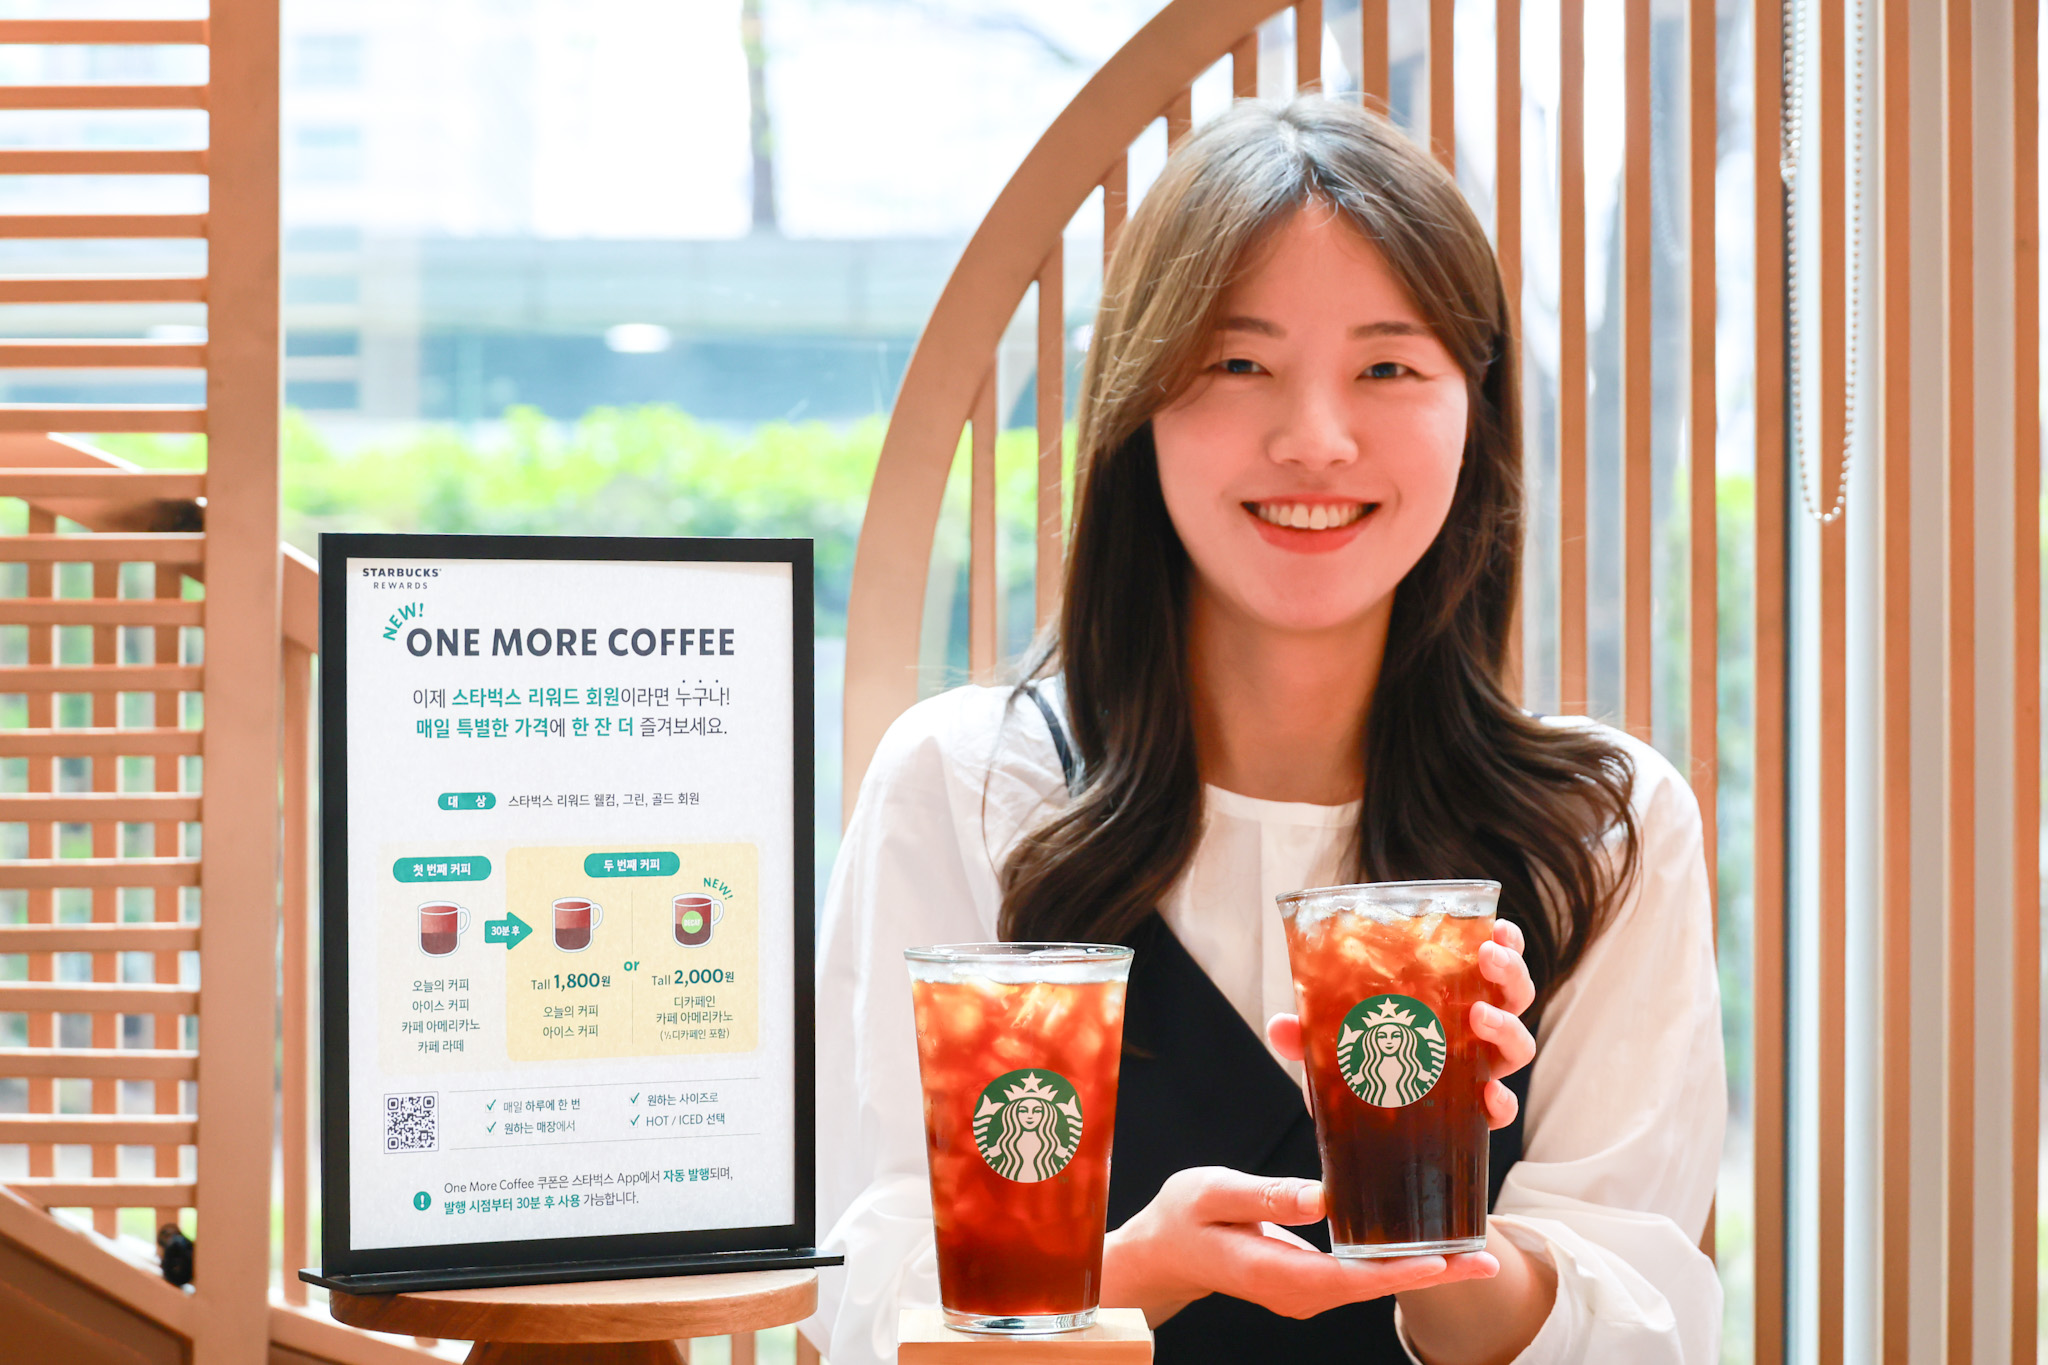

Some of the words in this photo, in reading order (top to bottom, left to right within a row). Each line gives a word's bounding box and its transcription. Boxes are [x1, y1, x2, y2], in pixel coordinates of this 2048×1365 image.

[383, 602, 424, 641] NEW!
[407, 628, 479, 657] ONE
[492, 628, 596, 656] MORE
[608, 628, 734, 656] COFFEE
[413, 689, 445, 708] 이제
[452, 688, 521, 707] 스타벅스
[529, 688, 579, 707] 리워드
[587, 687, 668, 707] 회원이라면
[676, 687, 729, 706] 누구나!
[417, 719, 449, 738] 매일
[457, 718, 509, 738] 특별한
[515, 718, 565, 737] 가격에
[572, 717, 589, 736] 한
[595, 717, 612, 736] 잔
[619, 717, 632, 736] 더
[640, 717, 727, 737] 즐겨보세요.
[509, 795, 553, 808] 스타벅스
[558, 794, 590, 807] 리워드
[595, 794, 619, 807] 웰컴,
[623, 793, 648, 807] 그린,
[652, 793, 674, 806] 골드
[678, 793, 699, 805] 회원
[413, 864, 423, 877] 첫
[427, 863, 447, 876] 번째
[451, 863, 470, 875] 커피
[604, 860, 614, 872] 두
[617, 859, 637, 871] 번째
[640, 858, 660, 871] 커피
[704, 878, 733, 900] NEW!
[491, 926, 512, 936] 30분
[511, 925, 520, 936] 후
[624, 961, 639, 971] or
[413, 979, 444, 993] 오늘의
[448, 978, 468, 991] 커피
[531, 979, 550, 990] Tall
[554, 973, 610, 991] 1,800원
[652, 975, 670, 985] Tall
[675, 969, 734, 987] 2,000원
[412, 1000, 444, 1013] 아이스
[449, 999, 469, 1011] 커피
[674, 996, 715, 1008] 디카페인
[543, 1006, 573, 1018] 오늘의
[578, 1005, 598, 1017] 커피
[657, 1012, 677, 1025] 카페
[681, 1011, 733, 1024] 아메리카노
[402, 1021, 423, 1034] 카페
[427, 1019, 480, 1033] 아메리카노
[543, 1026, 574, 1039] 아이스
[578, 1025, 598, 1037] 커피
[709, 1028, 729, 1039] 포함)
[418, 1041, 439, 1053] 카페
[443, 1040, 464, 1052] 라떼
[504, 1101, 522, 1113] 매일
[526, 1099, 554, 1112] 하루에
[558, 1099, 567, 1110] 한
[571, 1098, 580, 1110] 번
[648, 1094, 676, 1106] 원하는
[679, 1093, 718, 1104] 사이즈로
[647, 1116, 669, 1126] HOT
[679, 1114, 703, 1125] ICED
[706, 1113, 725, 1125] 선택
[505, 1123, 533, 1135] 원하는
[537, 1120, 575, 1133] 매장에서
[444, 1183, 466, 1193] One
[470, 1181, 497, 1191] More
[500, 1178, 534, 1190] Coffee
[538, 1176, 569, 1189] 쿠폰은
[572, 1173, 614, 1187] 스타벅스
[617, 1170, 659, 1186] App에서
[664, 1169, 685, 1182] 자동
[689, 1167, 732, 1181] 발행되며,
[445, 1201, 465, 1215] 발행
[469, 1198, 512, 1213] 시점부터
[517, 1197, 540, 1209] 30분
[544, 1195, 555, 1208] 후
[558, 1194, 580, 1207] 사용
[584, 1191, 638, 1206] 가능합니다.
